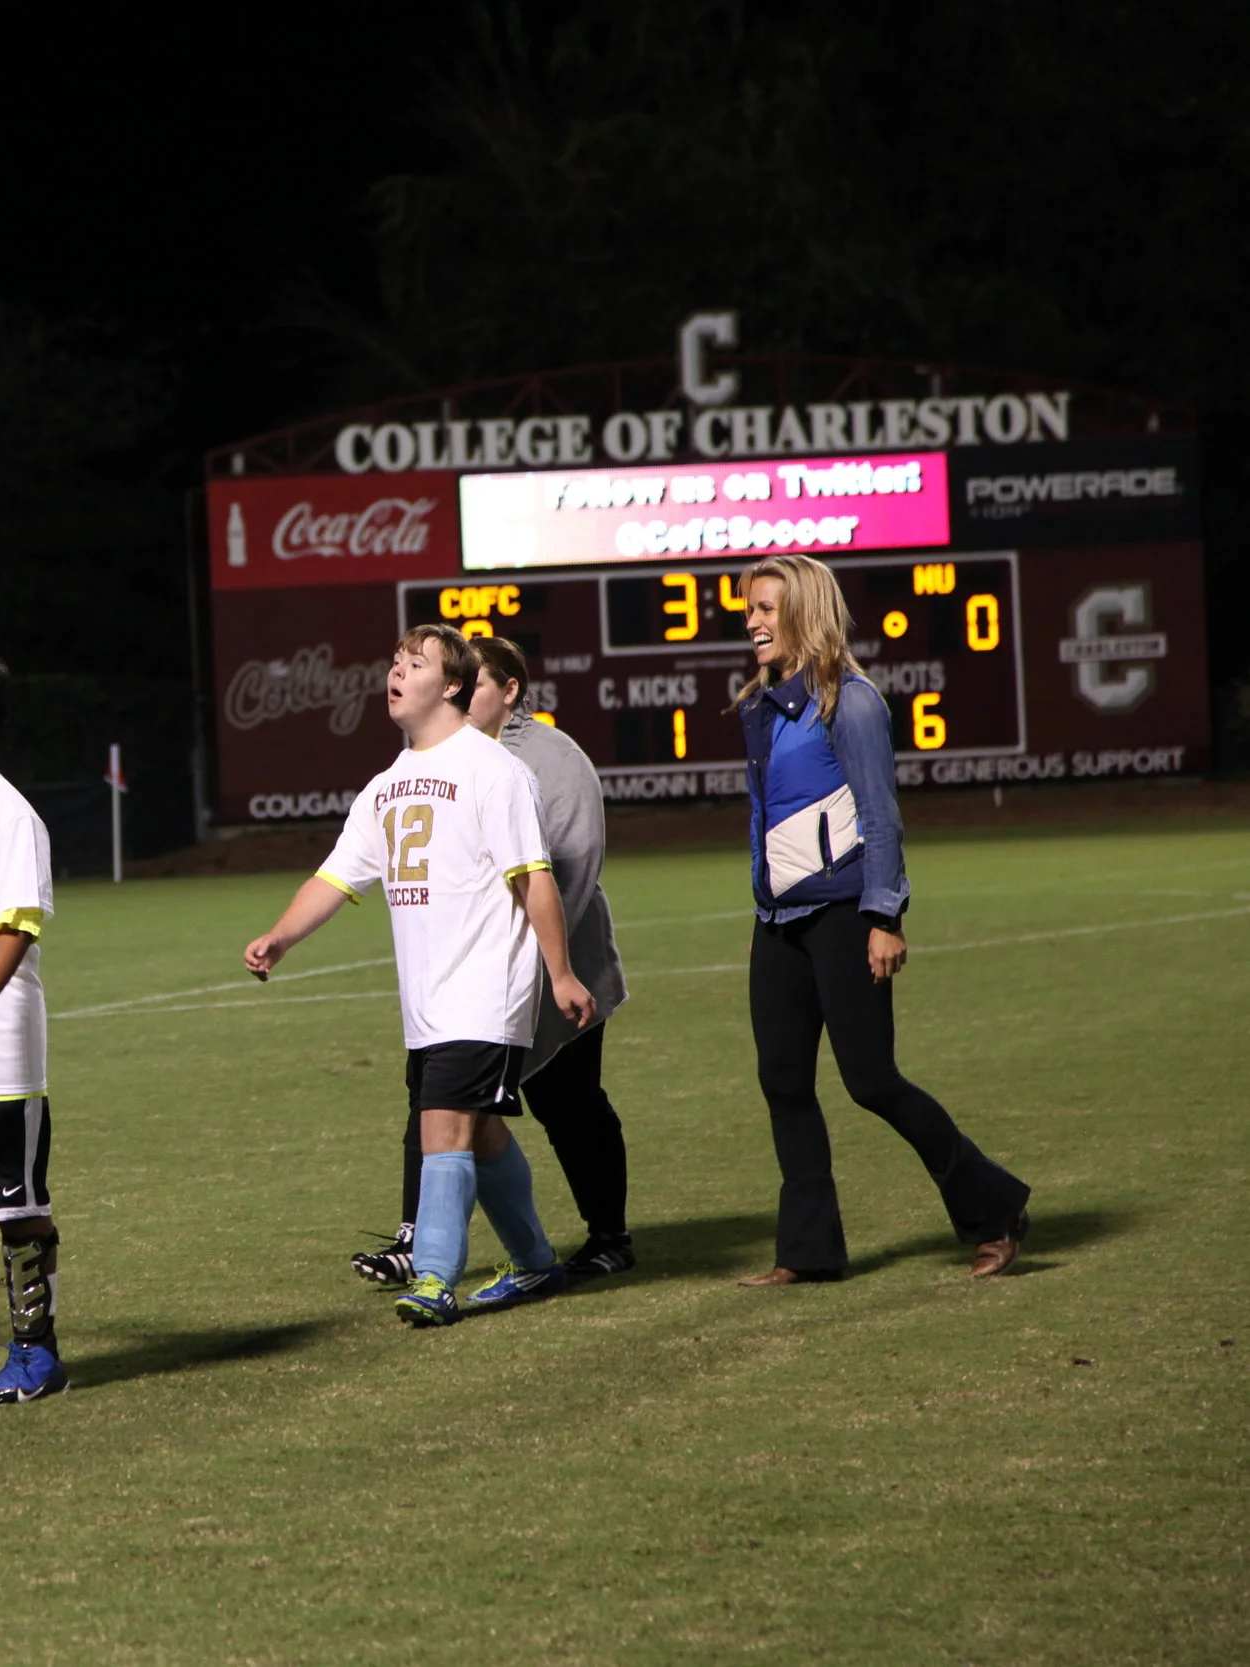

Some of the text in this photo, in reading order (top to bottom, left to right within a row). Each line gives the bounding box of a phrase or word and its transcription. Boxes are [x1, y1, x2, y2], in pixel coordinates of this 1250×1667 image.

[681, 313, 736, 402] C
[335, 392, 1070, 474] COLLEGE OF CHARLESTON
[723, 472, 772, 501] on
[966, 467, 1177, 504] POWERADE
[439, 584, 521, 619] COFC
[966, 594, 1000, 652] 0
[598, 674, 698, 710] C. KICKS
[868, 661, 946, 694] SHOTS
[672, 708, 687, 760] 1
[912, 692, 946, 750] 6
[249, 791, 357, 819] COUGAR
[601, 773, 698, 800] AMONN
[931, 751, 1066, 784] GENEROUS
[1072, 745, 1186, 776] SUPPORT
[374, 778, 458, 812] CARLESTON
[383, 804, 434, 883] 12
[387, 887, 429, 906] OCCER
